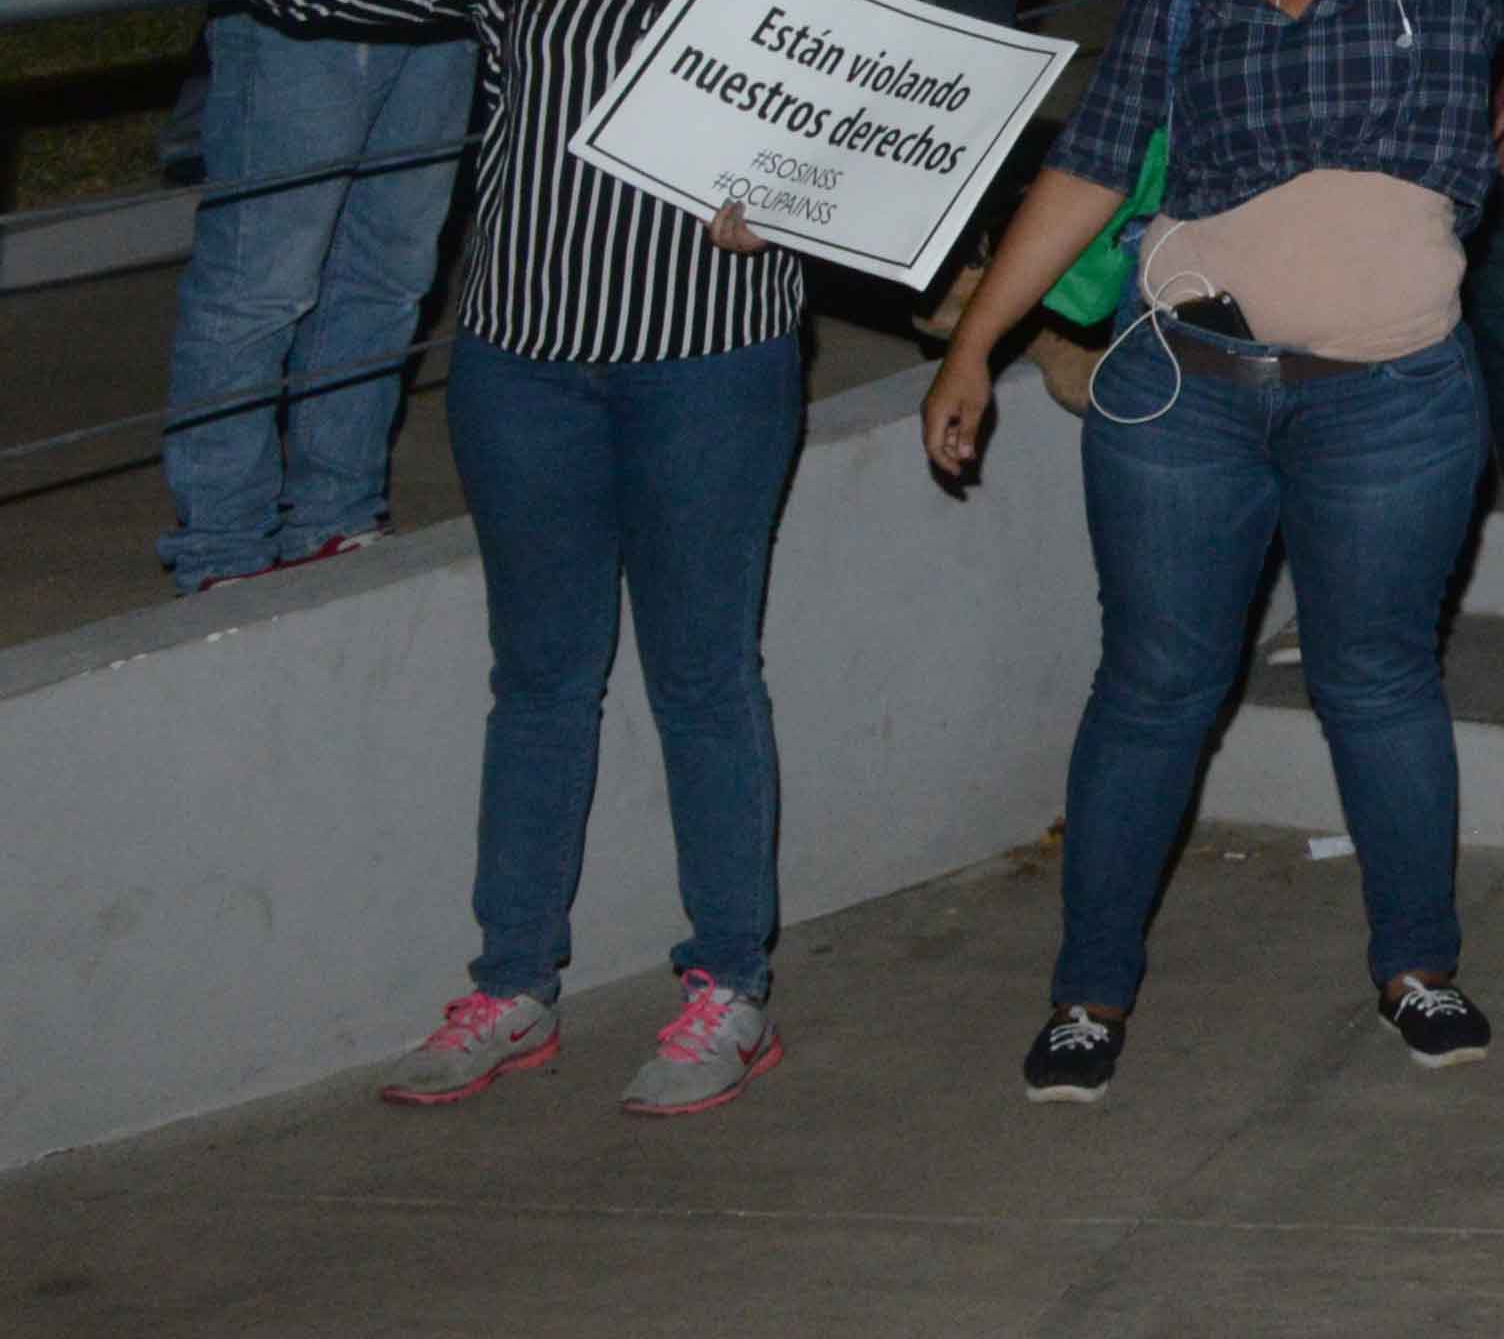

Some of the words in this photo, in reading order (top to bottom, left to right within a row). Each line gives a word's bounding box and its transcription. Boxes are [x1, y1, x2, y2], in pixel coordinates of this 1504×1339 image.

[751, 5, 847, 77] Están
[847, 51, 971, 114] violando
[670, 44, 832, 140] nuestros
[828, 106, 968, 176] derechos
[712, 170, 838, 225] #OCUPAINSS
[751, 148, 844, 190] #SOSINSS
